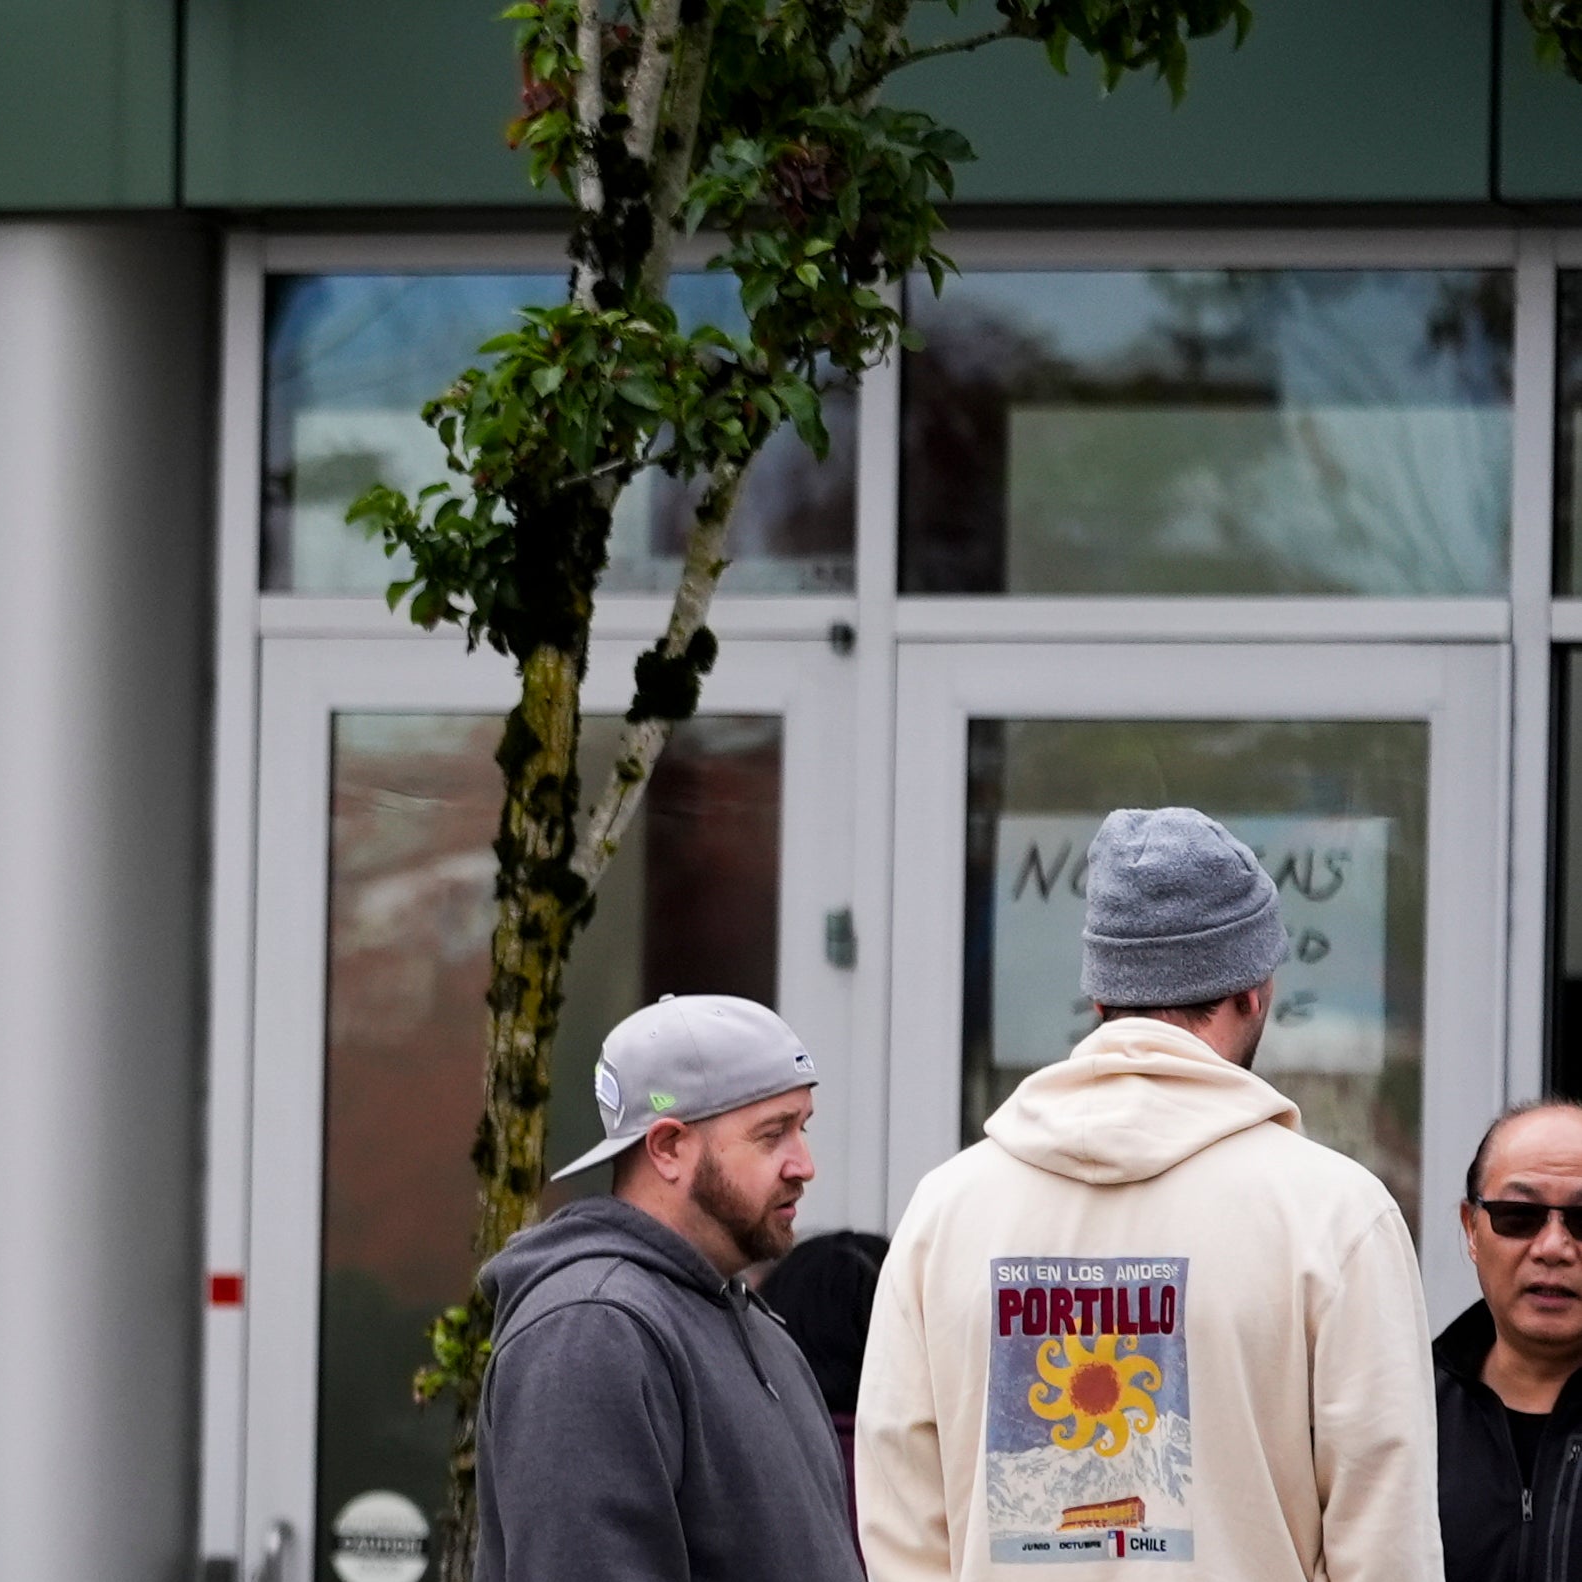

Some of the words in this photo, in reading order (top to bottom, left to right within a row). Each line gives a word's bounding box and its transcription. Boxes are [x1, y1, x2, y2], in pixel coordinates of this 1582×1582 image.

[998, 1265, 1029, 1281] SKI
[1036, 1265, 1061, 1281] EN
[1068, 1266, 1104, 1281] LOS
[1116, 1264, 1172, 1280] ANDES
[998, 1285, 1176, 1336] PORTILLO
[1130, 1537, 1167, 1552] CHILE
